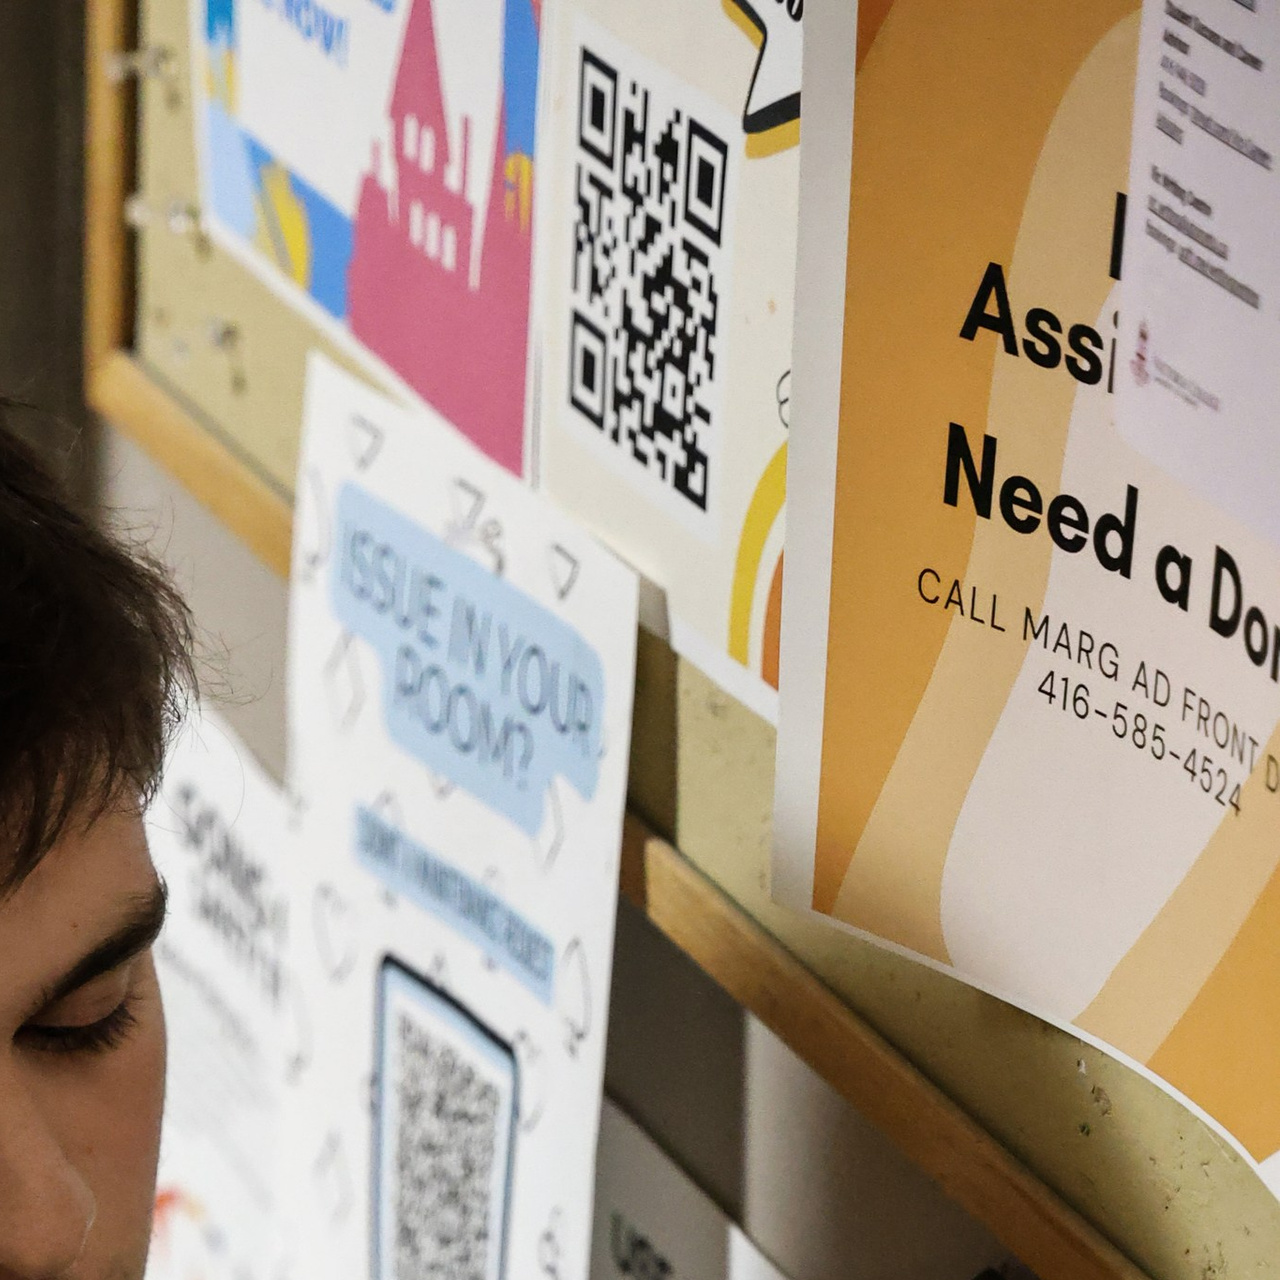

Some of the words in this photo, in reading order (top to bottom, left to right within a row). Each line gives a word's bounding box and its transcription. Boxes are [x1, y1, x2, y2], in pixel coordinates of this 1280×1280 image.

[943, 422, 1138, 579] Need
[1155, 544, 1193, 611] a
[341, 522, 446, 650] ISSUE
[448, 596, 493, 677] IN
[497, 621, 593, 757] YOUR
[394, 645, 534, 790] ROOM?
[918, 568, 1006, 632] CALL
[1023, 607, 1120, 681] MARG
[1132, 661, 1171, 707] AD
[1181, 687, 1259, 775] FRONT
[1038, 671, 1242, 816] 416-585-4524
